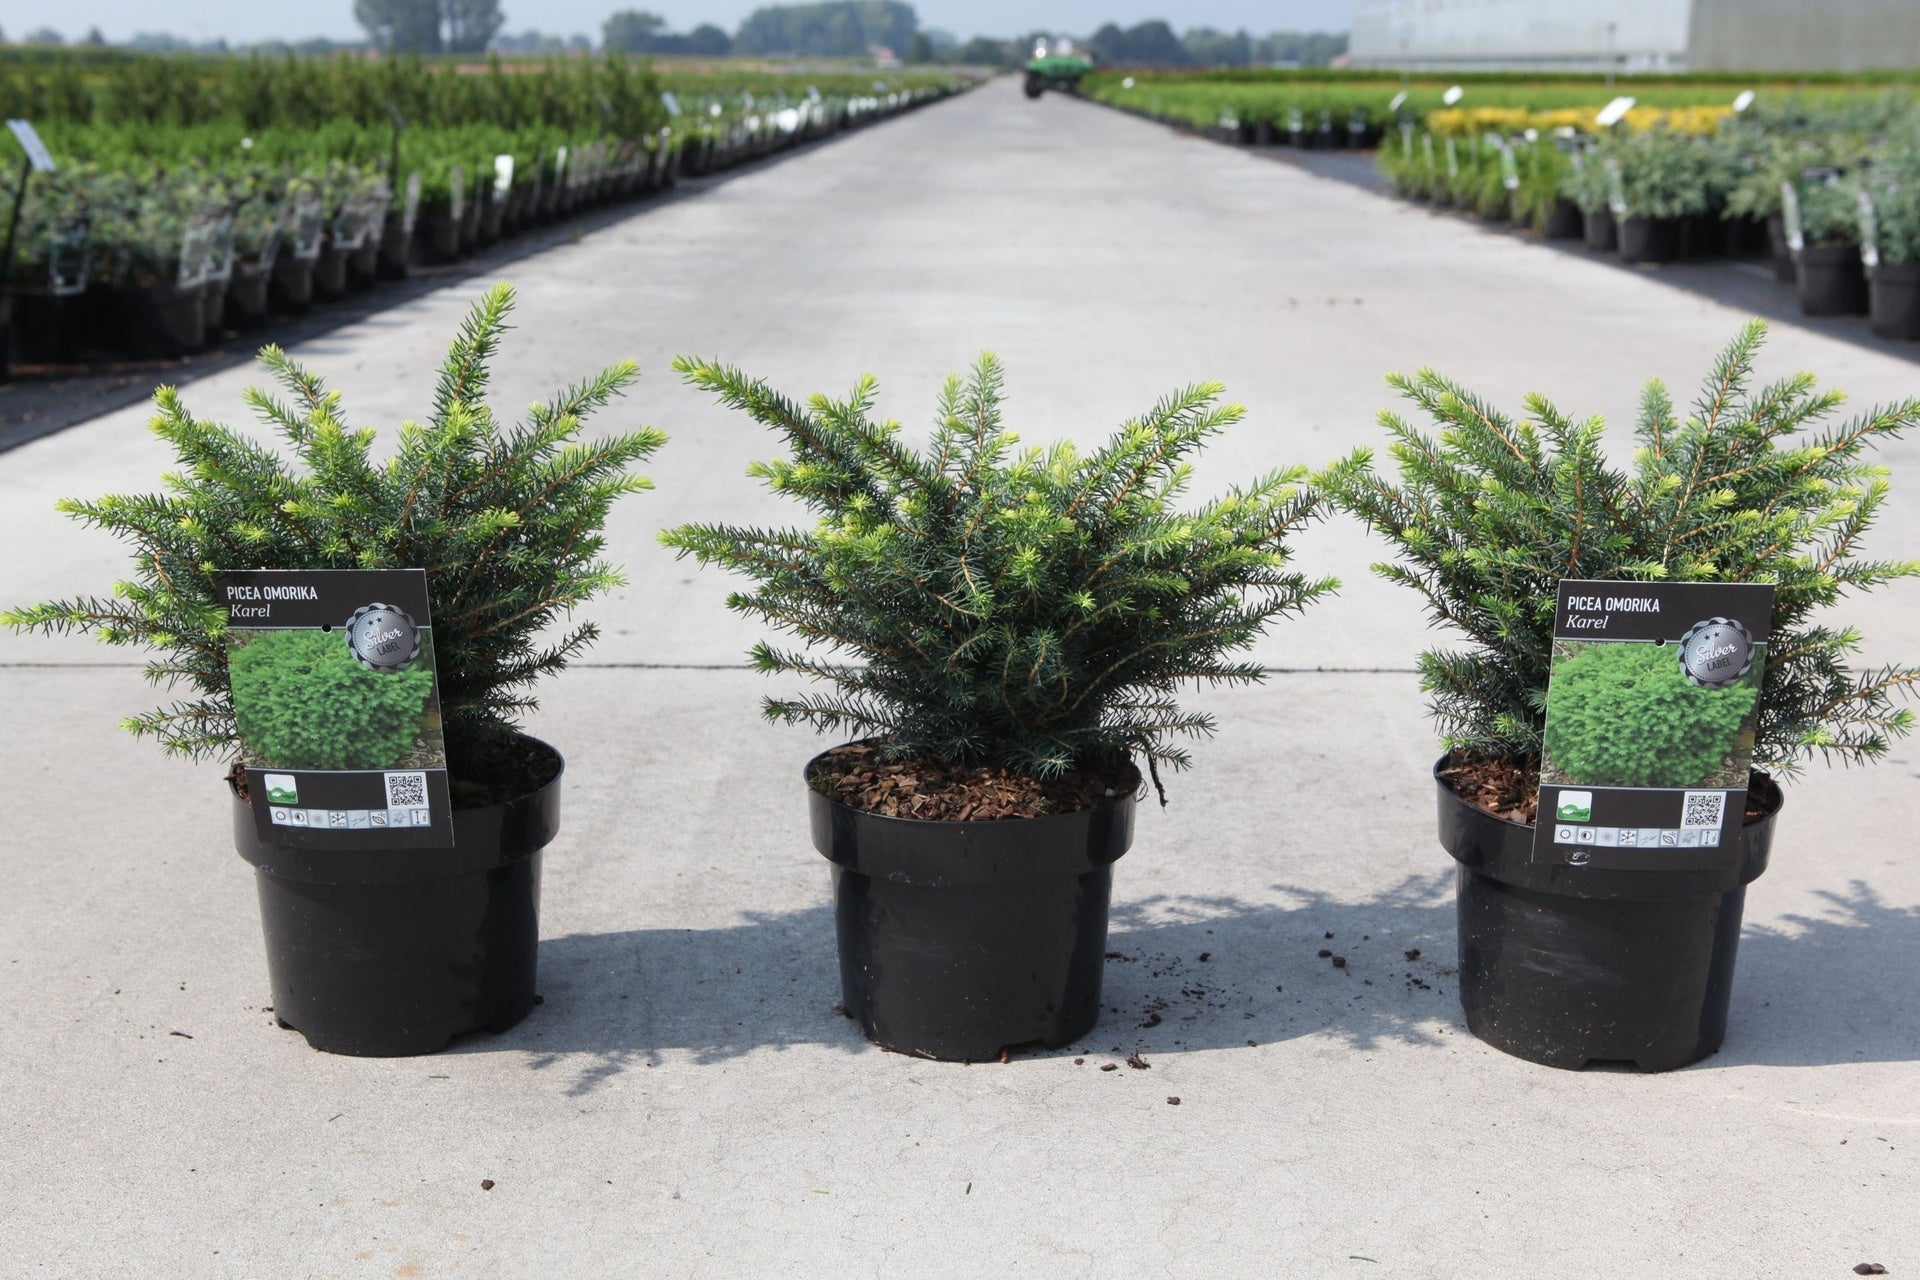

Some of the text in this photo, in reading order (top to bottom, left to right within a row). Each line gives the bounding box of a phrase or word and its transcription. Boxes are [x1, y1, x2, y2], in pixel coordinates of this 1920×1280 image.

[227, 586, 318, 600] PICEA OMORIKA
[231, 604, 271, 617] Karel
[1567, 596, 1660, 612] PICEA OMORIKA
[1565, 614, 1609, 629] Karel
[362, 627, 403, 650] Silver
[376, 641, 401, 656] LABEL
[1695, 643, 1737, 665] Silver
[1706, 657, 1732, 672] LABEL
